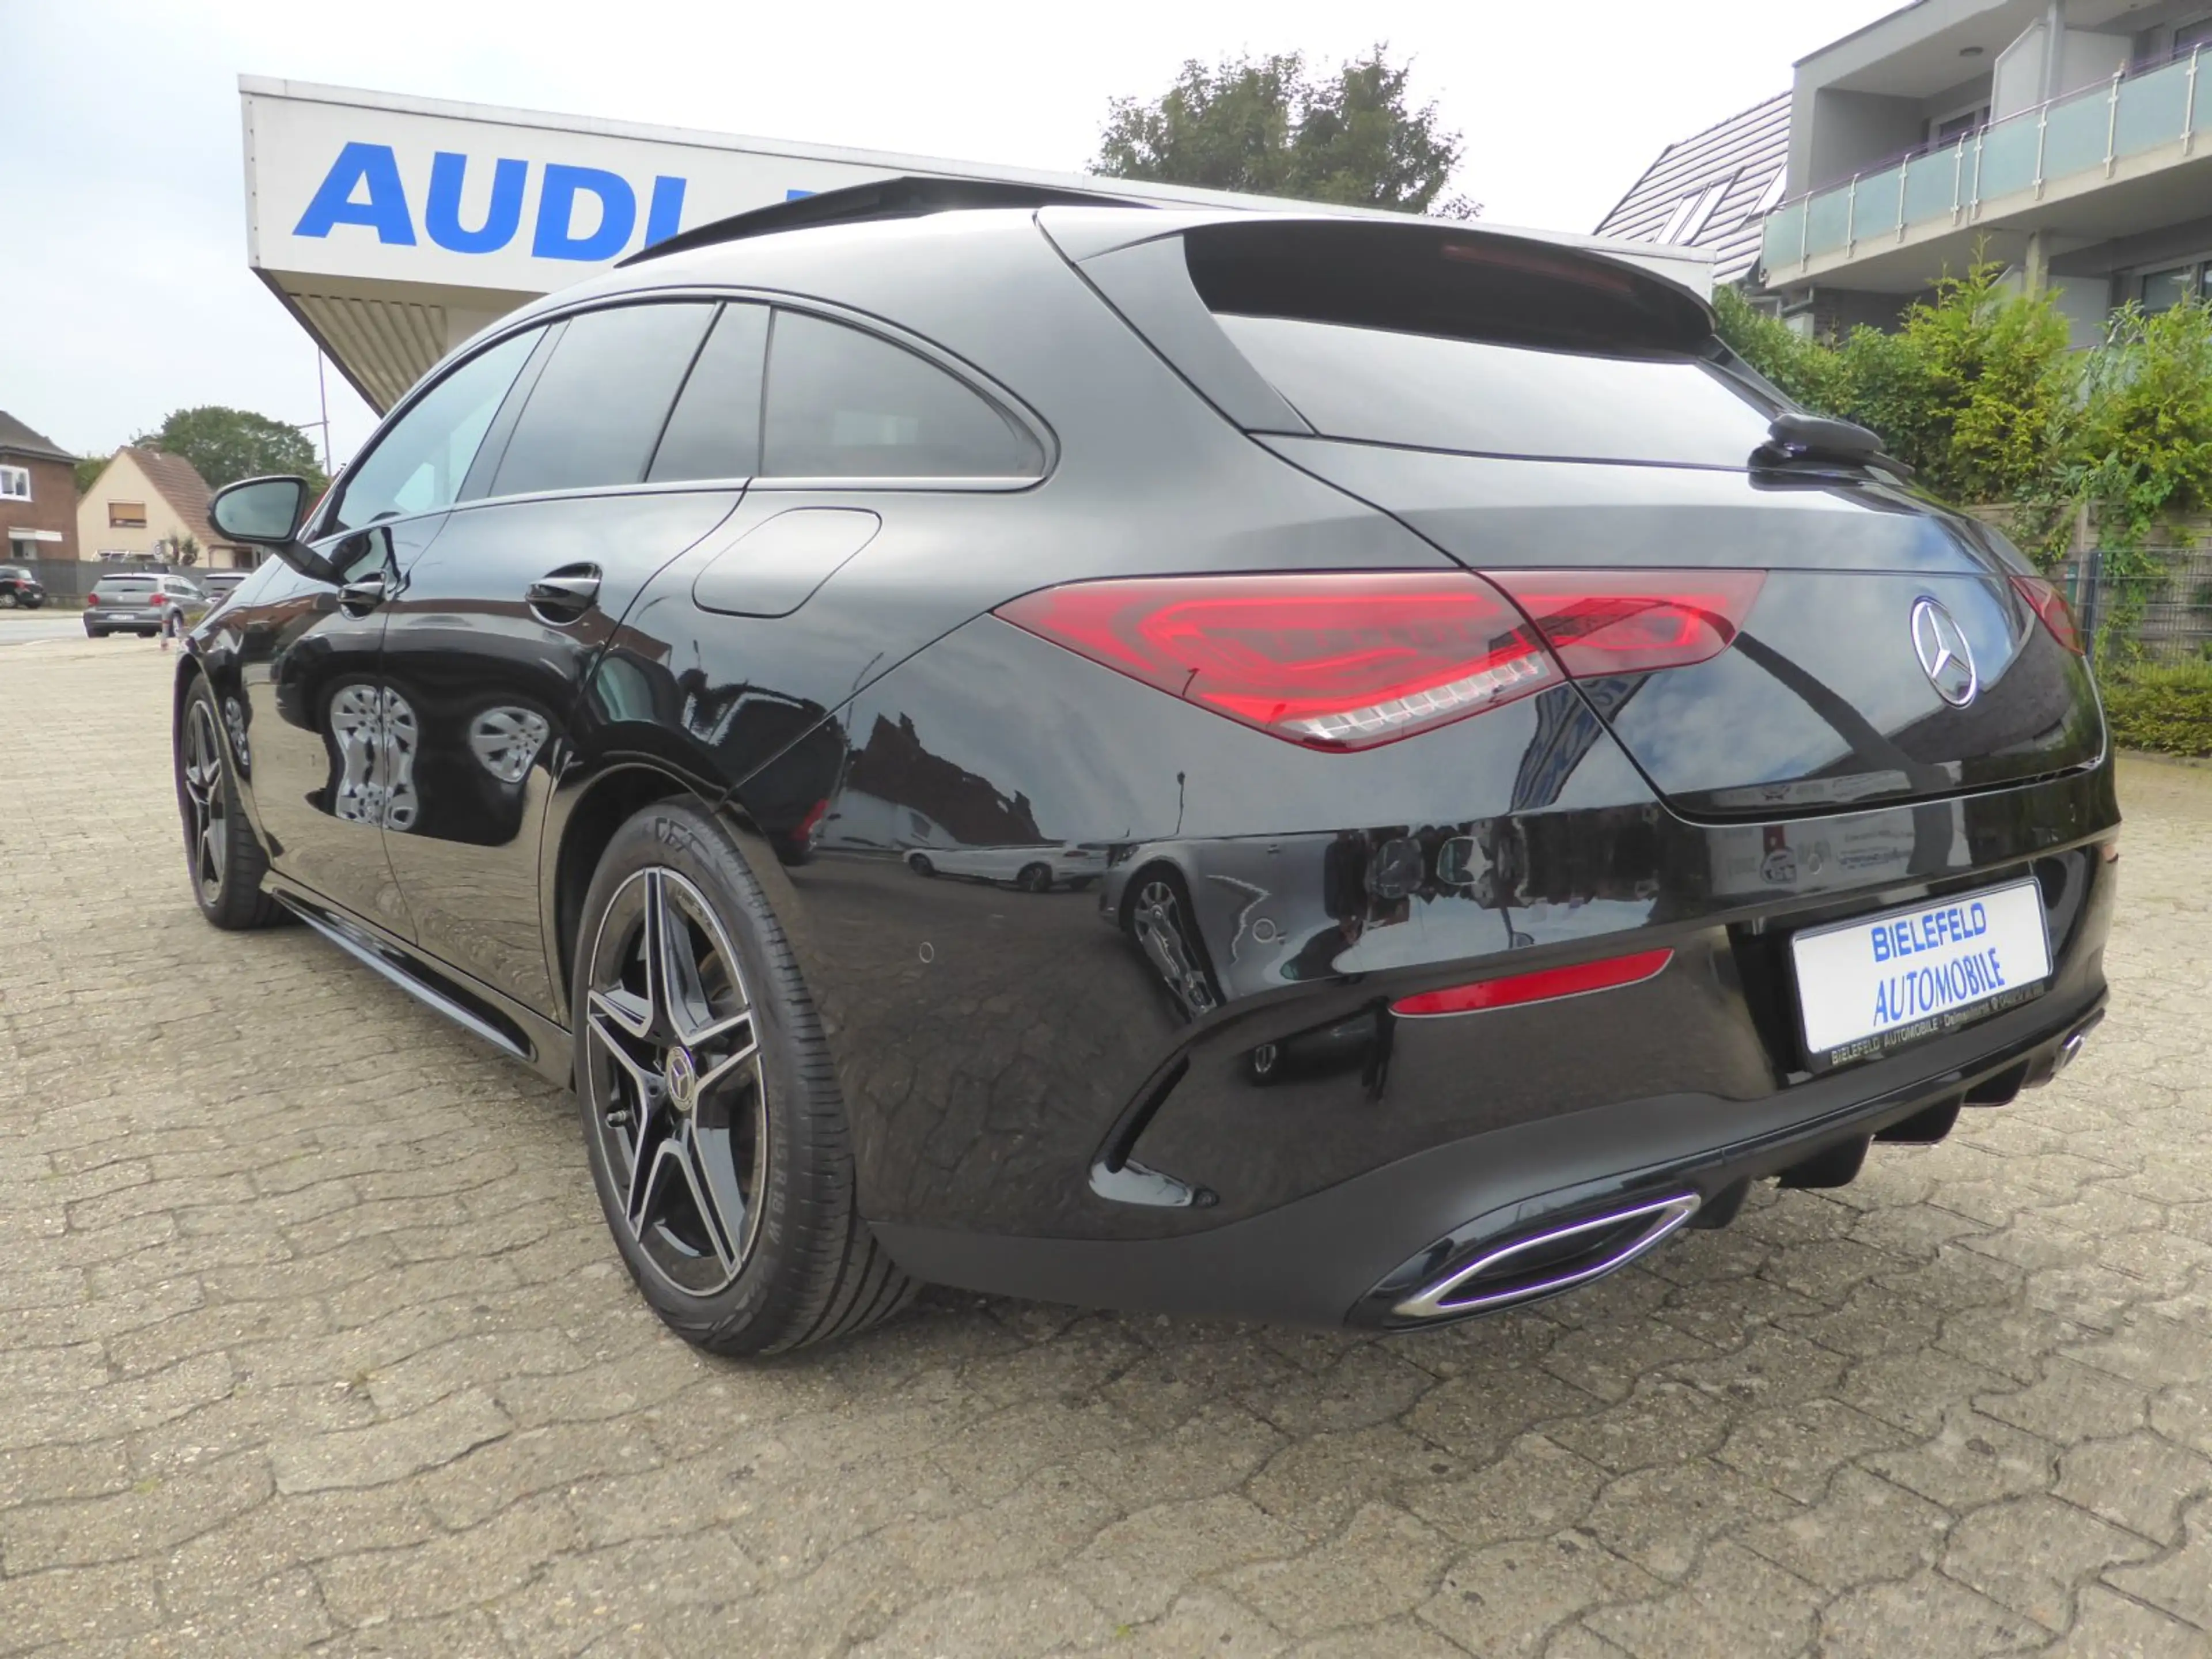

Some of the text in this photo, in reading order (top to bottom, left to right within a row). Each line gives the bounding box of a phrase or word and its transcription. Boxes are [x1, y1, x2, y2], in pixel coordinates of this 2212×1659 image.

[292, 142, 687, 262] AUDI
[1870, 902, 1986, 963] BIELEFELD
[1873, 948, 2005, 1027] AUTOMOBILE
[1831, 1037, 1880, 1065] BIELEFELD
[1884, 1017, 1939, 1048] AUTOMOBILE
